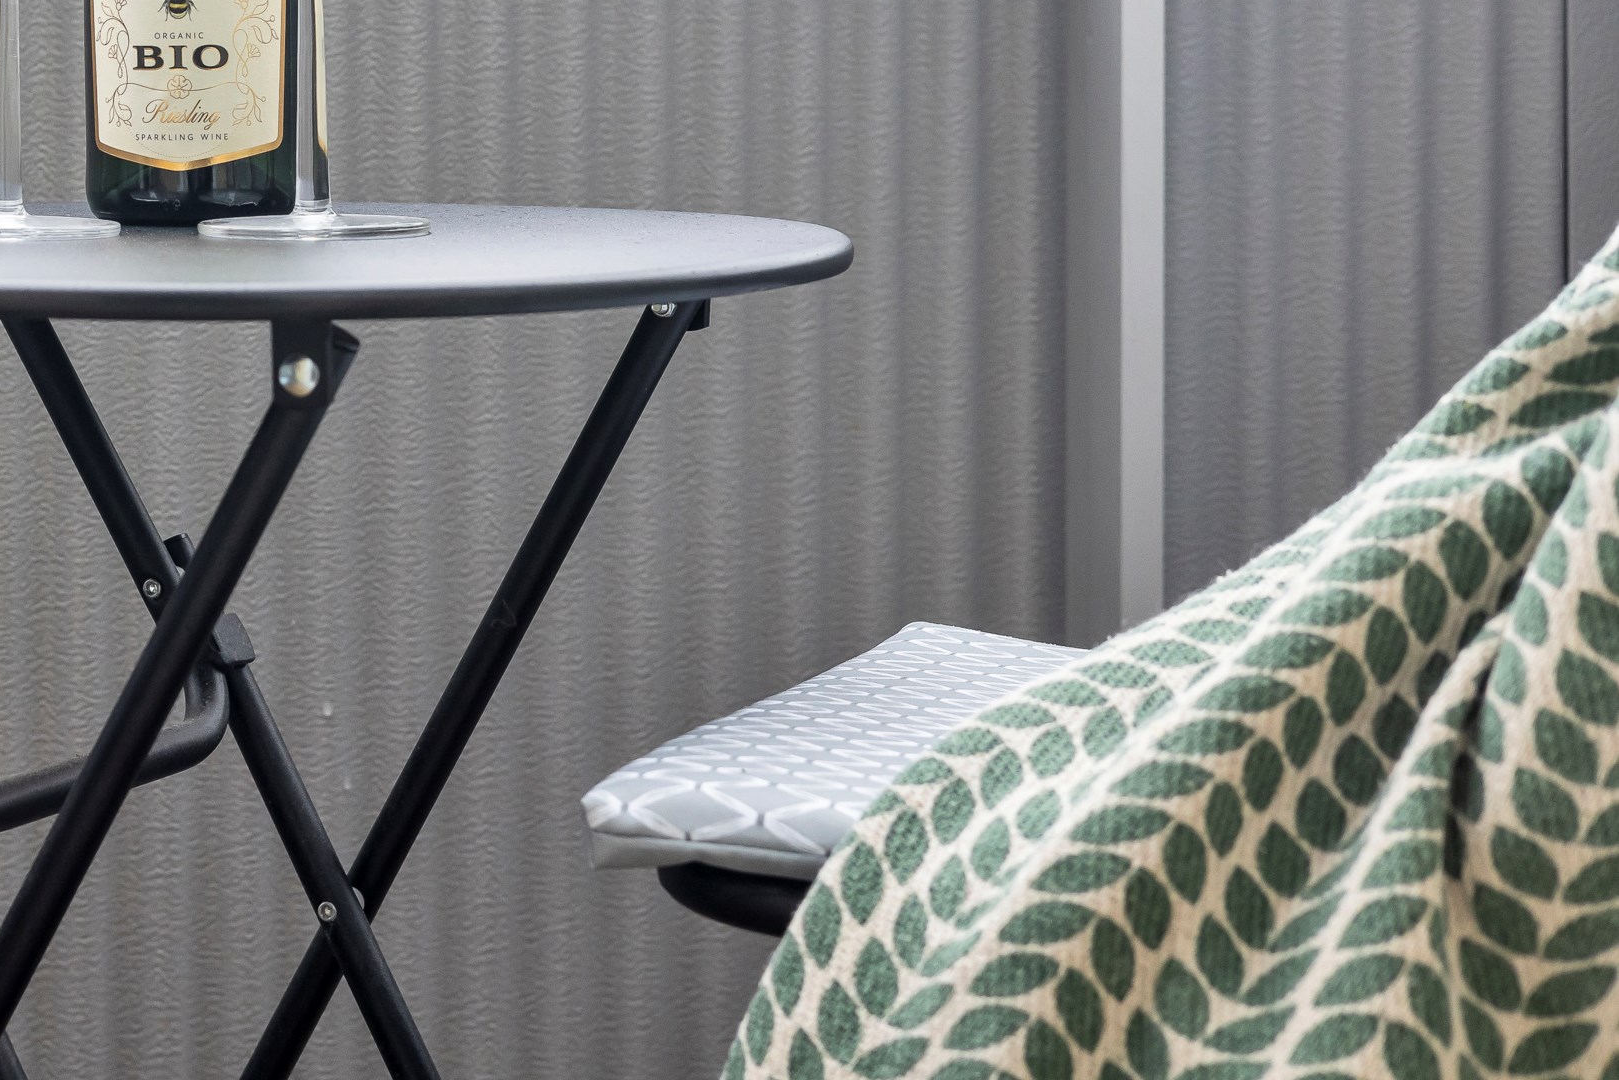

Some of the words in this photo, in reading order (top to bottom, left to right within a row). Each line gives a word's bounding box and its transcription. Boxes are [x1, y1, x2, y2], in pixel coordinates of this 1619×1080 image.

[154, 31, 204, 40] ORGANIC
[132, 44, 229, 71] BIO
[142, 98, 221, 130] Riesling
[135, 133, 194, 141] SPARKLING
[200, 133, 229, 141] WINE
